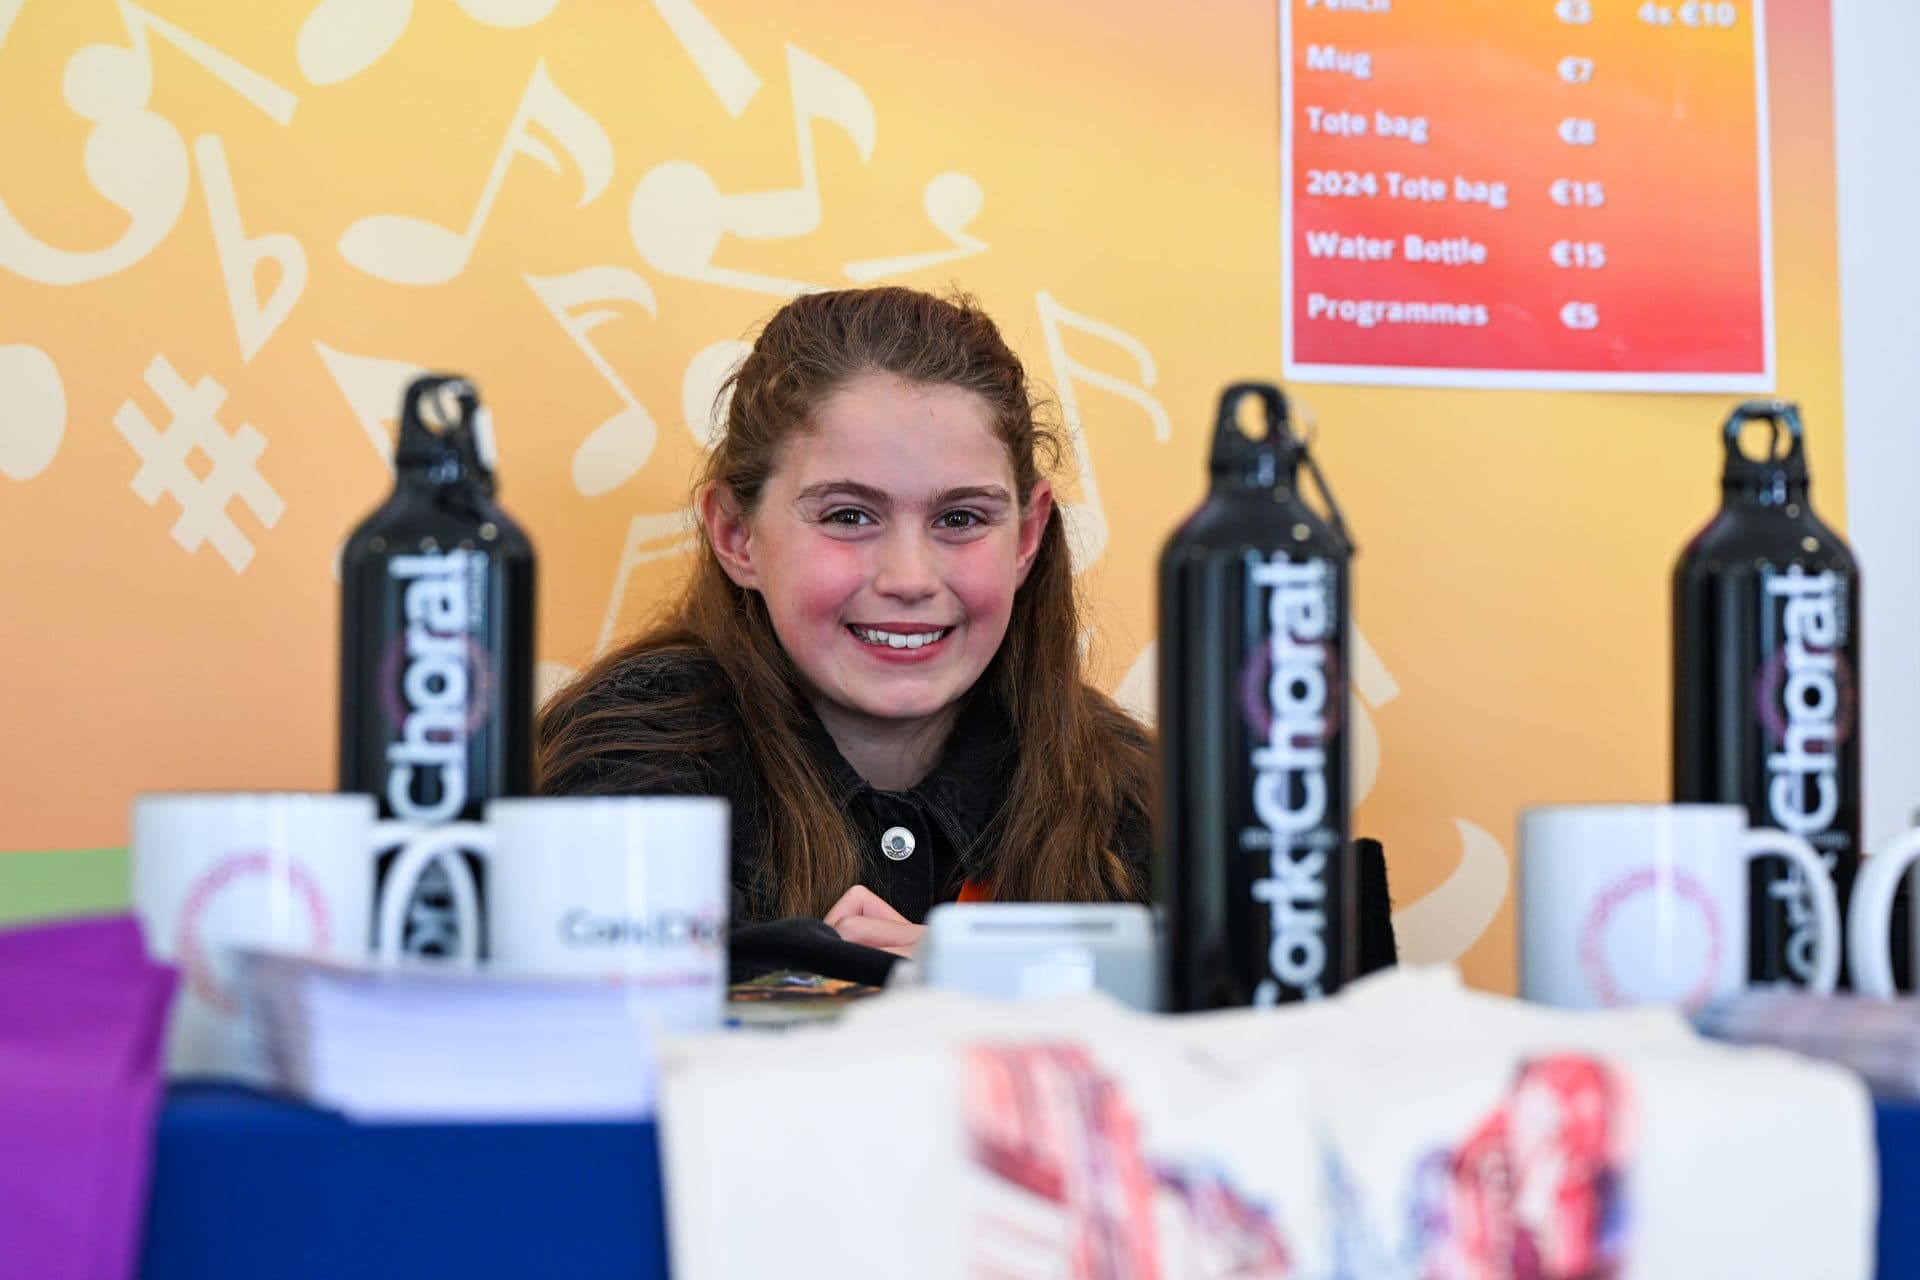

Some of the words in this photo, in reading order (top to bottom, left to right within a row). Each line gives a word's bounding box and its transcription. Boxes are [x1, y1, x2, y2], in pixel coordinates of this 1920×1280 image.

[1555, 0, 1594, 24] €3
[1638, 2, 1673, 26] 4x
[1679, 1, 1737, 28] €10
[1306, 45, 1372, 79] Mug
[1558, 56, 1595, 83] €7
[1306, 106, 1368, 138] Tote
[1375, 109, 1429, 144] bag
[1558, 119, 1597, 146] €8
[1306, 169, 1378, 198] 2024
[1385, 171, 1447, 202] Tote
[1454, 174, 1508, 209] bag
[1550, 179, 1605, 207] €15
[1306, 230, 1396, 262] Water
[1403, 234, 1487, 266] Bottle
[1551, 241, 1606, 268] €15
[1307, 292, 1488, 327] Programmes
[1560, 303, 1599, 329] €5
